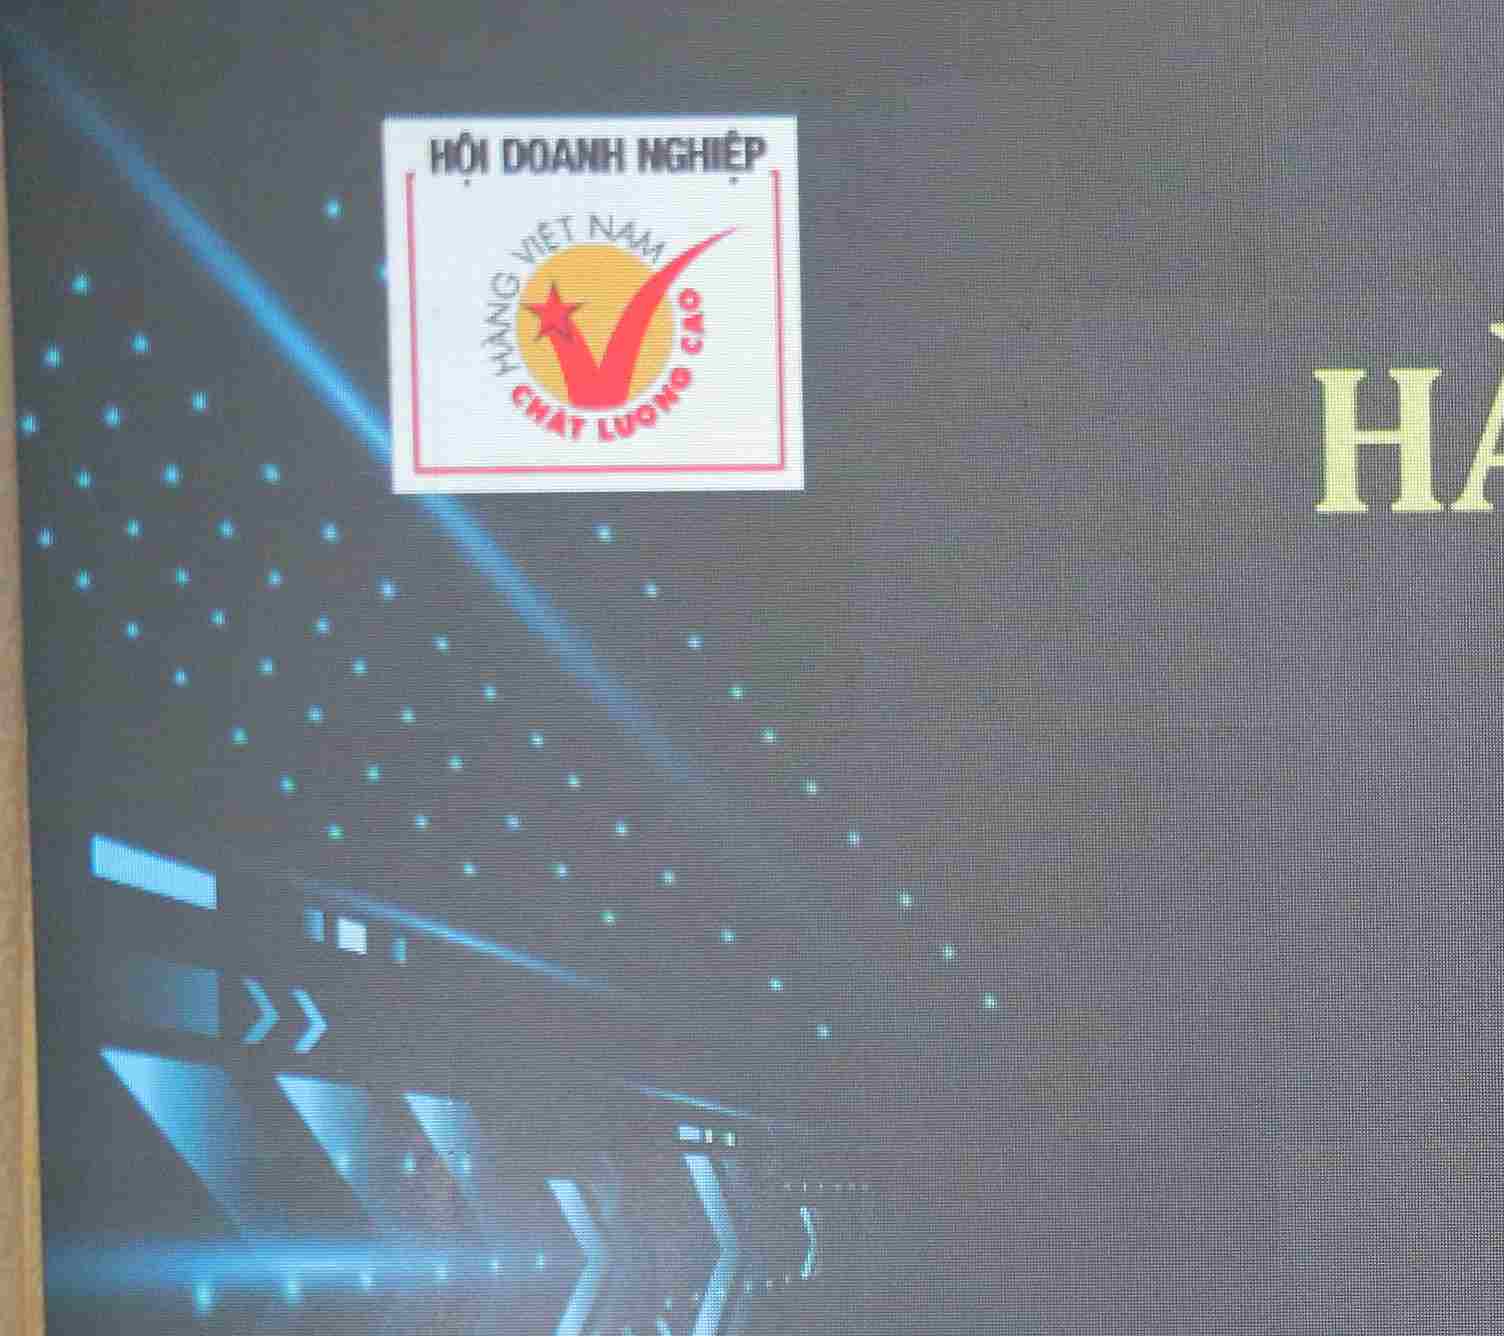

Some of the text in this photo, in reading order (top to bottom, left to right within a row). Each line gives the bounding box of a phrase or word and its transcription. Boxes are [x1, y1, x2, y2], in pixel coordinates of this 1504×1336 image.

[431, 129, 767, 187] HỘI DOANH NGHIỆP
[590, 213, 667, 265] NAM
[677, 286, 706, 355] CAO
